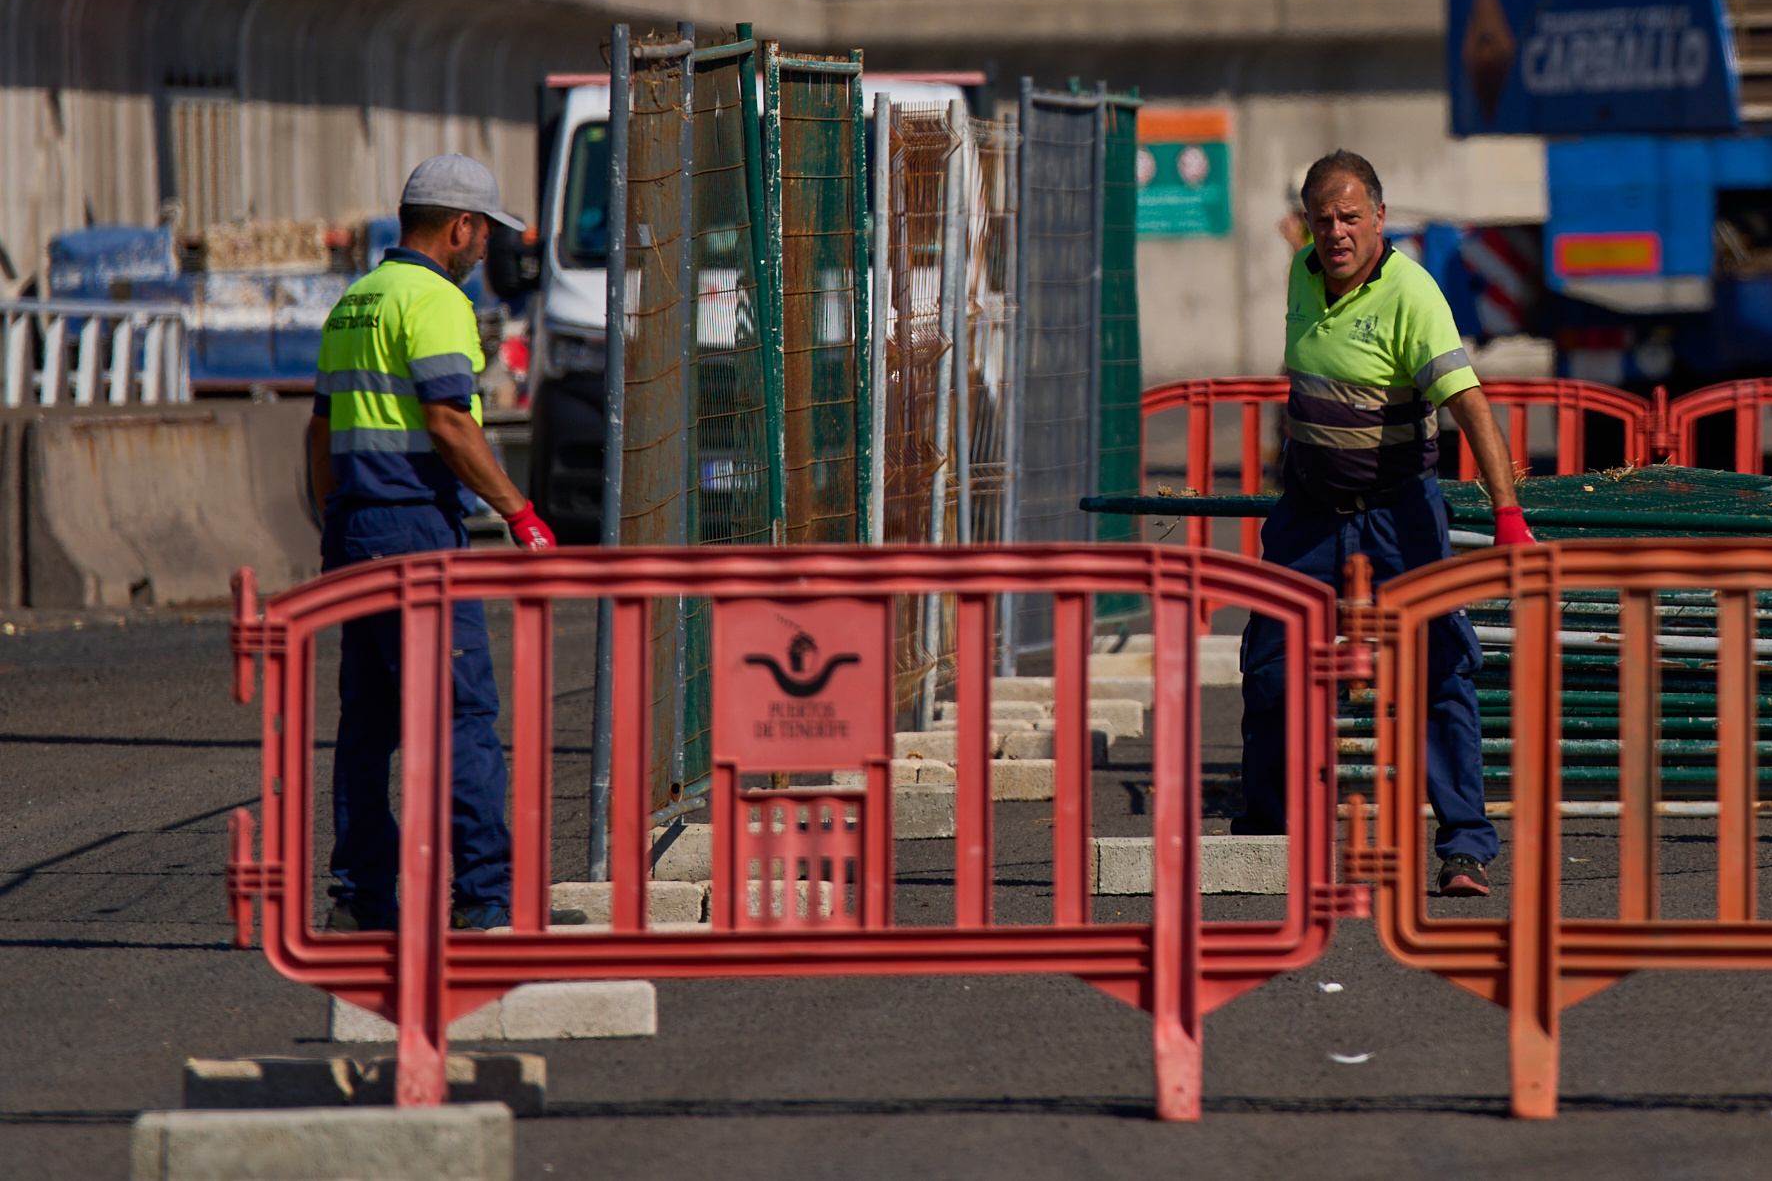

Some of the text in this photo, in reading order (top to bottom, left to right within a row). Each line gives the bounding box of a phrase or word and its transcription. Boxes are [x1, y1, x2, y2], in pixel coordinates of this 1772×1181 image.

[1520, 25, 1710, 96] CARBALLO
[768, 700, 836, 719] PUERTOS
[753, 720, 851, 739] DE TENERIFE
